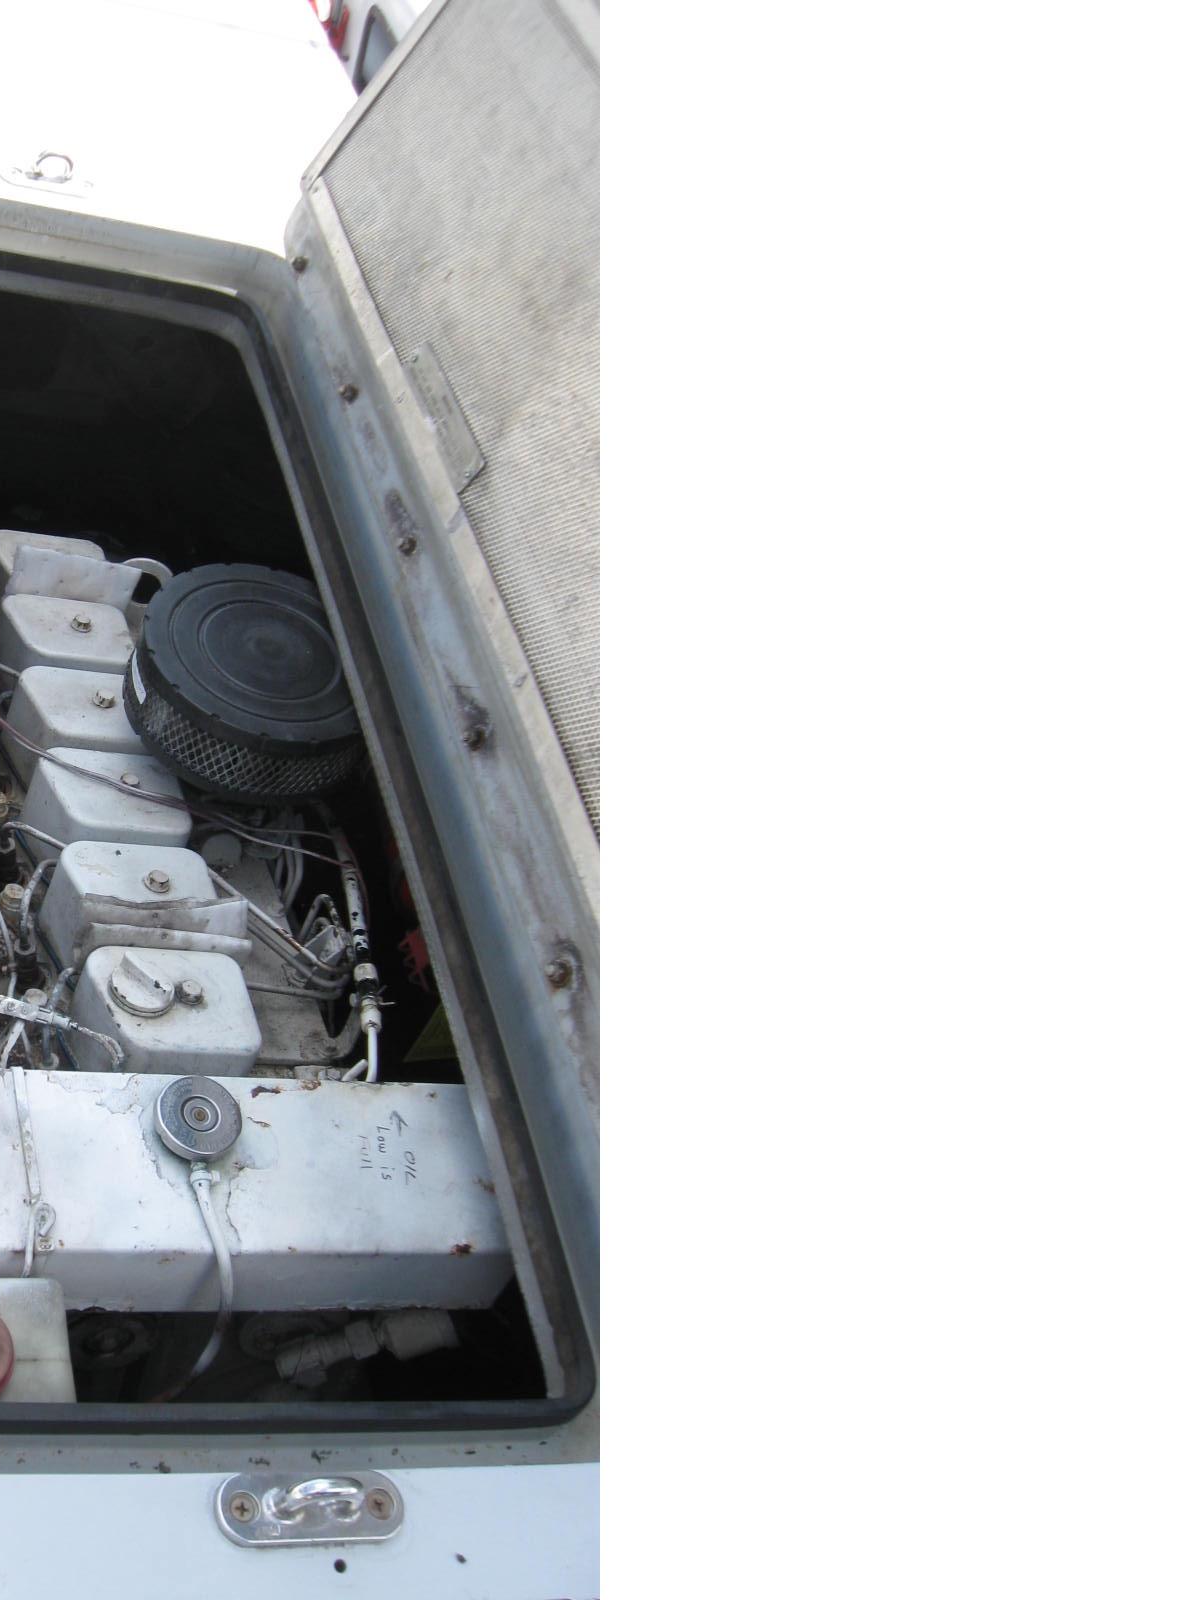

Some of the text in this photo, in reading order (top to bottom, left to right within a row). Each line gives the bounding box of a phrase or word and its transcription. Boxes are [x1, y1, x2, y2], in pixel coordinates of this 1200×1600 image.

[375, 1125, 396, 1181] Low is
[403, 1150, 417, 1186] OIL
